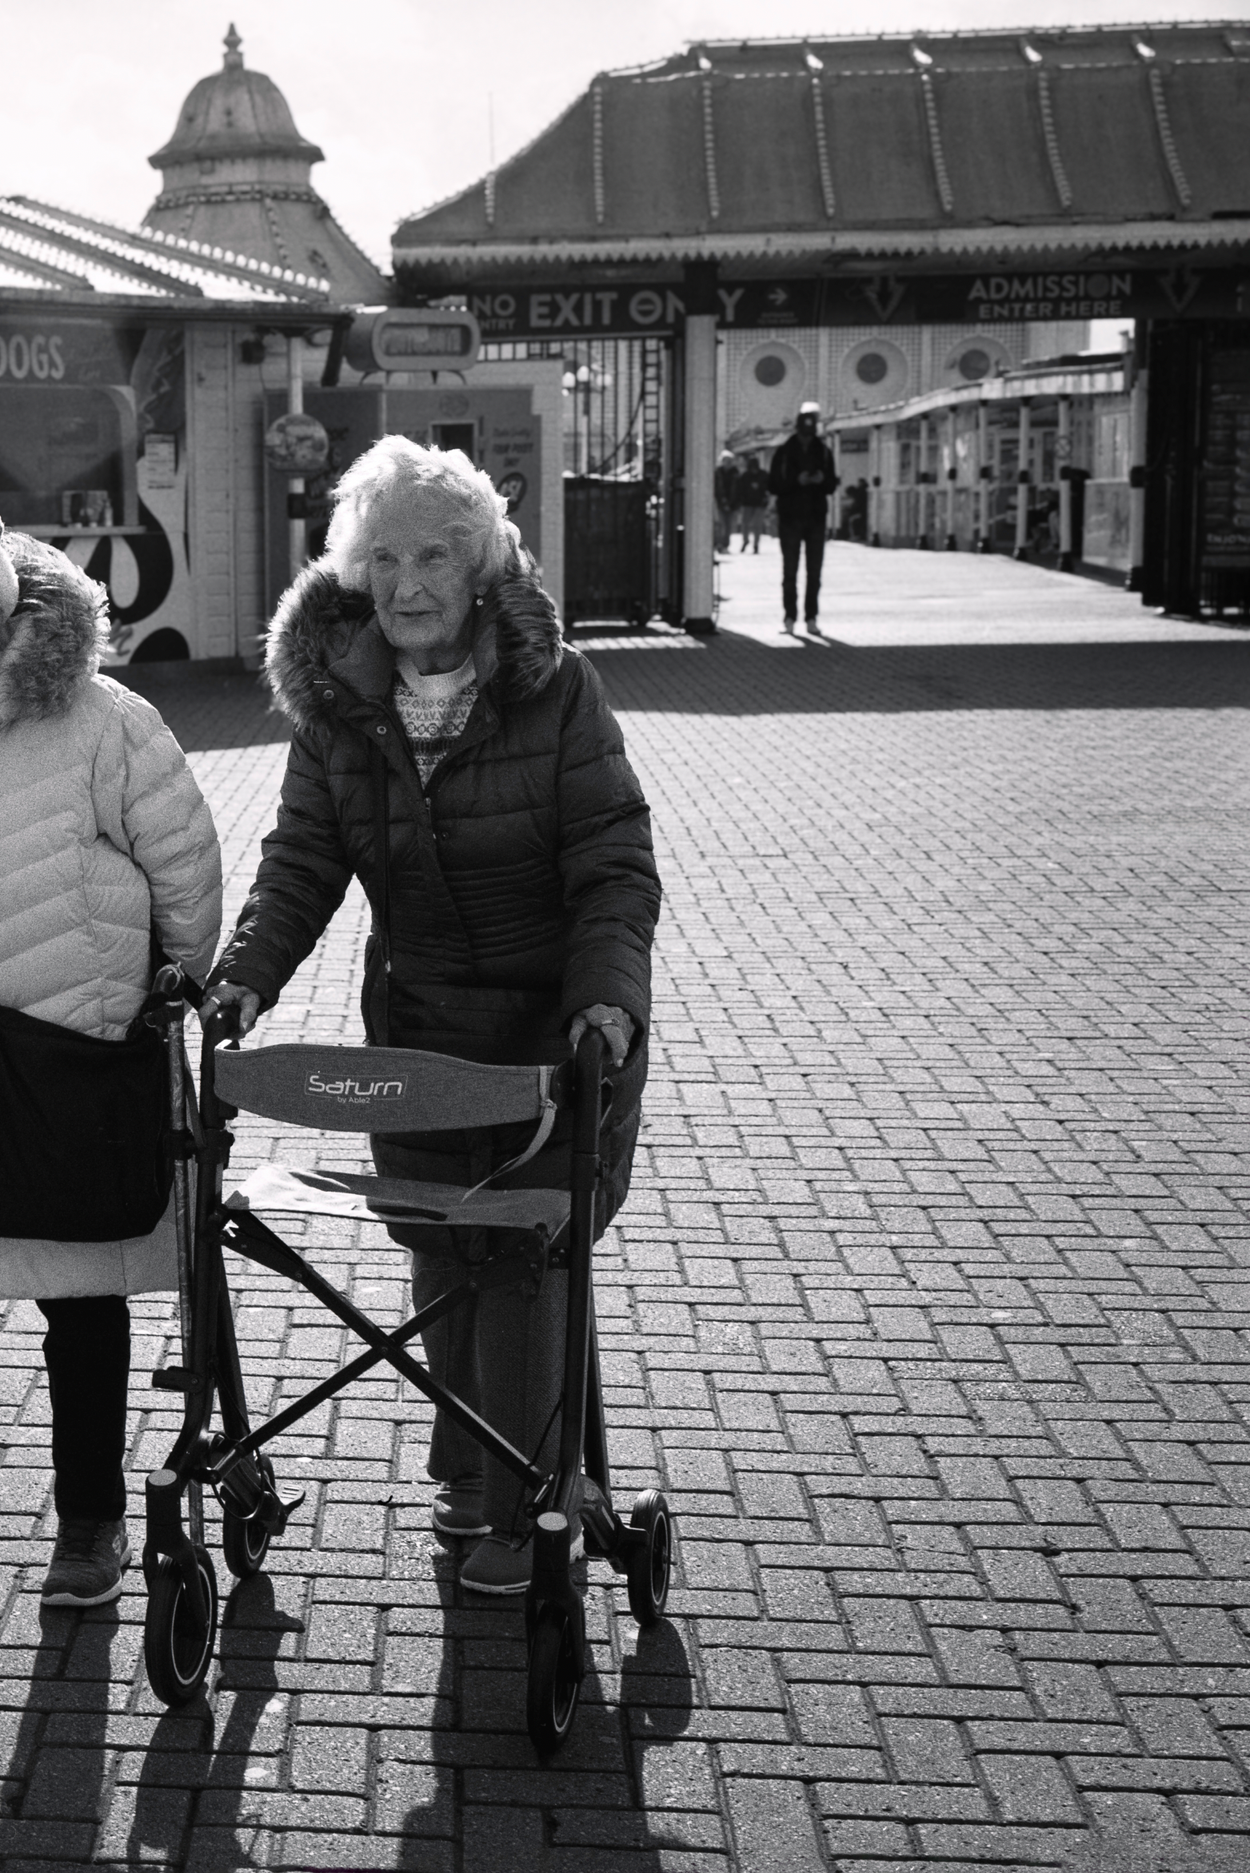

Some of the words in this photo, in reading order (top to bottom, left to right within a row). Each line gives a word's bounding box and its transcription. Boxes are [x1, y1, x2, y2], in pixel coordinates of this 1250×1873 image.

[967, 273, 1132, 300] ADMISSION
[472, 293, 516, 317] NO
[530, 293, 618, 327] EXIT
[629, 289, 744, 325] ONY
[978, 302, 1053, 319] ENTER
[1061, 300, 1122, 317] HERE
[477, 318, 516, 331] NTRY
[308, 1075, 403, 1095] Saturn
[348, 1096, 371, 1104] Able2
